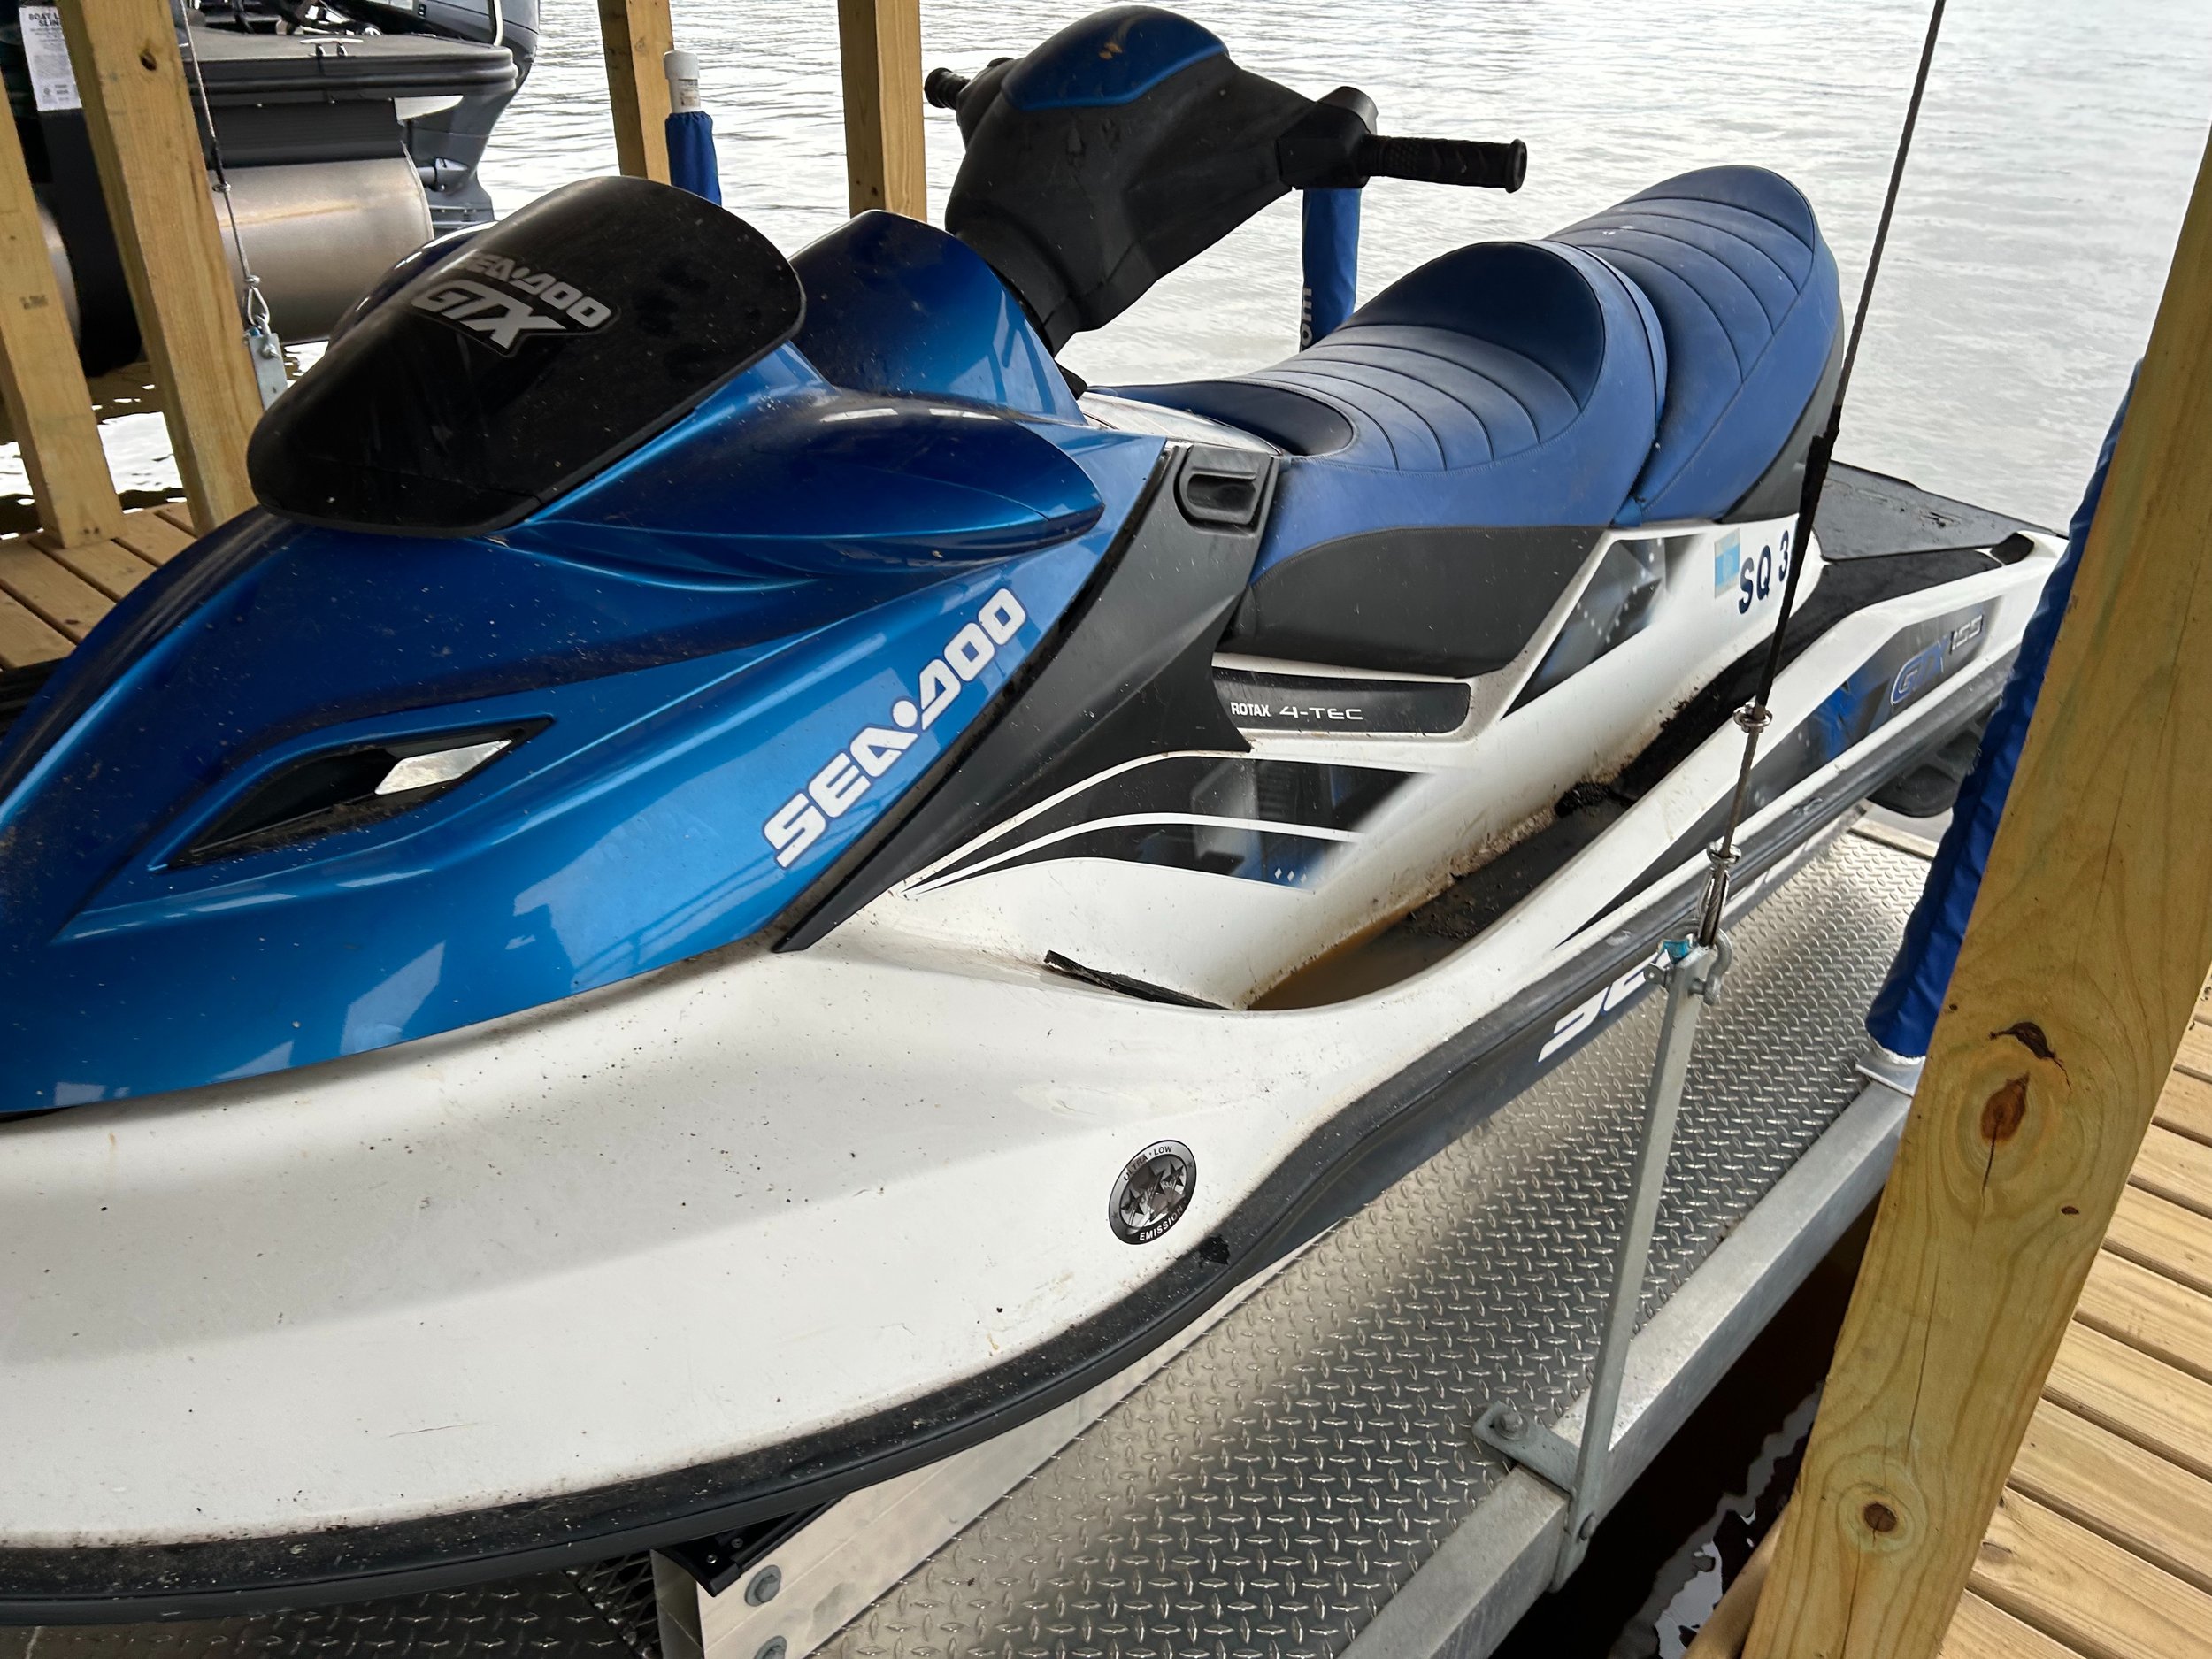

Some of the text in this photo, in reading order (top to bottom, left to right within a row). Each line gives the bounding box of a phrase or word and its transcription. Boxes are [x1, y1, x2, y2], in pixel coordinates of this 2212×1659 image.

[411, 279, 566, 349] GTX
[1739, 545, 1771, 614] SQ
[1231, 702, 1363, 720] ROTAX 4-TEC
[1123, 1146, 1172, 1181] ULTRA LOW
[1139, 1205, 1184, 1240] EMISSION
